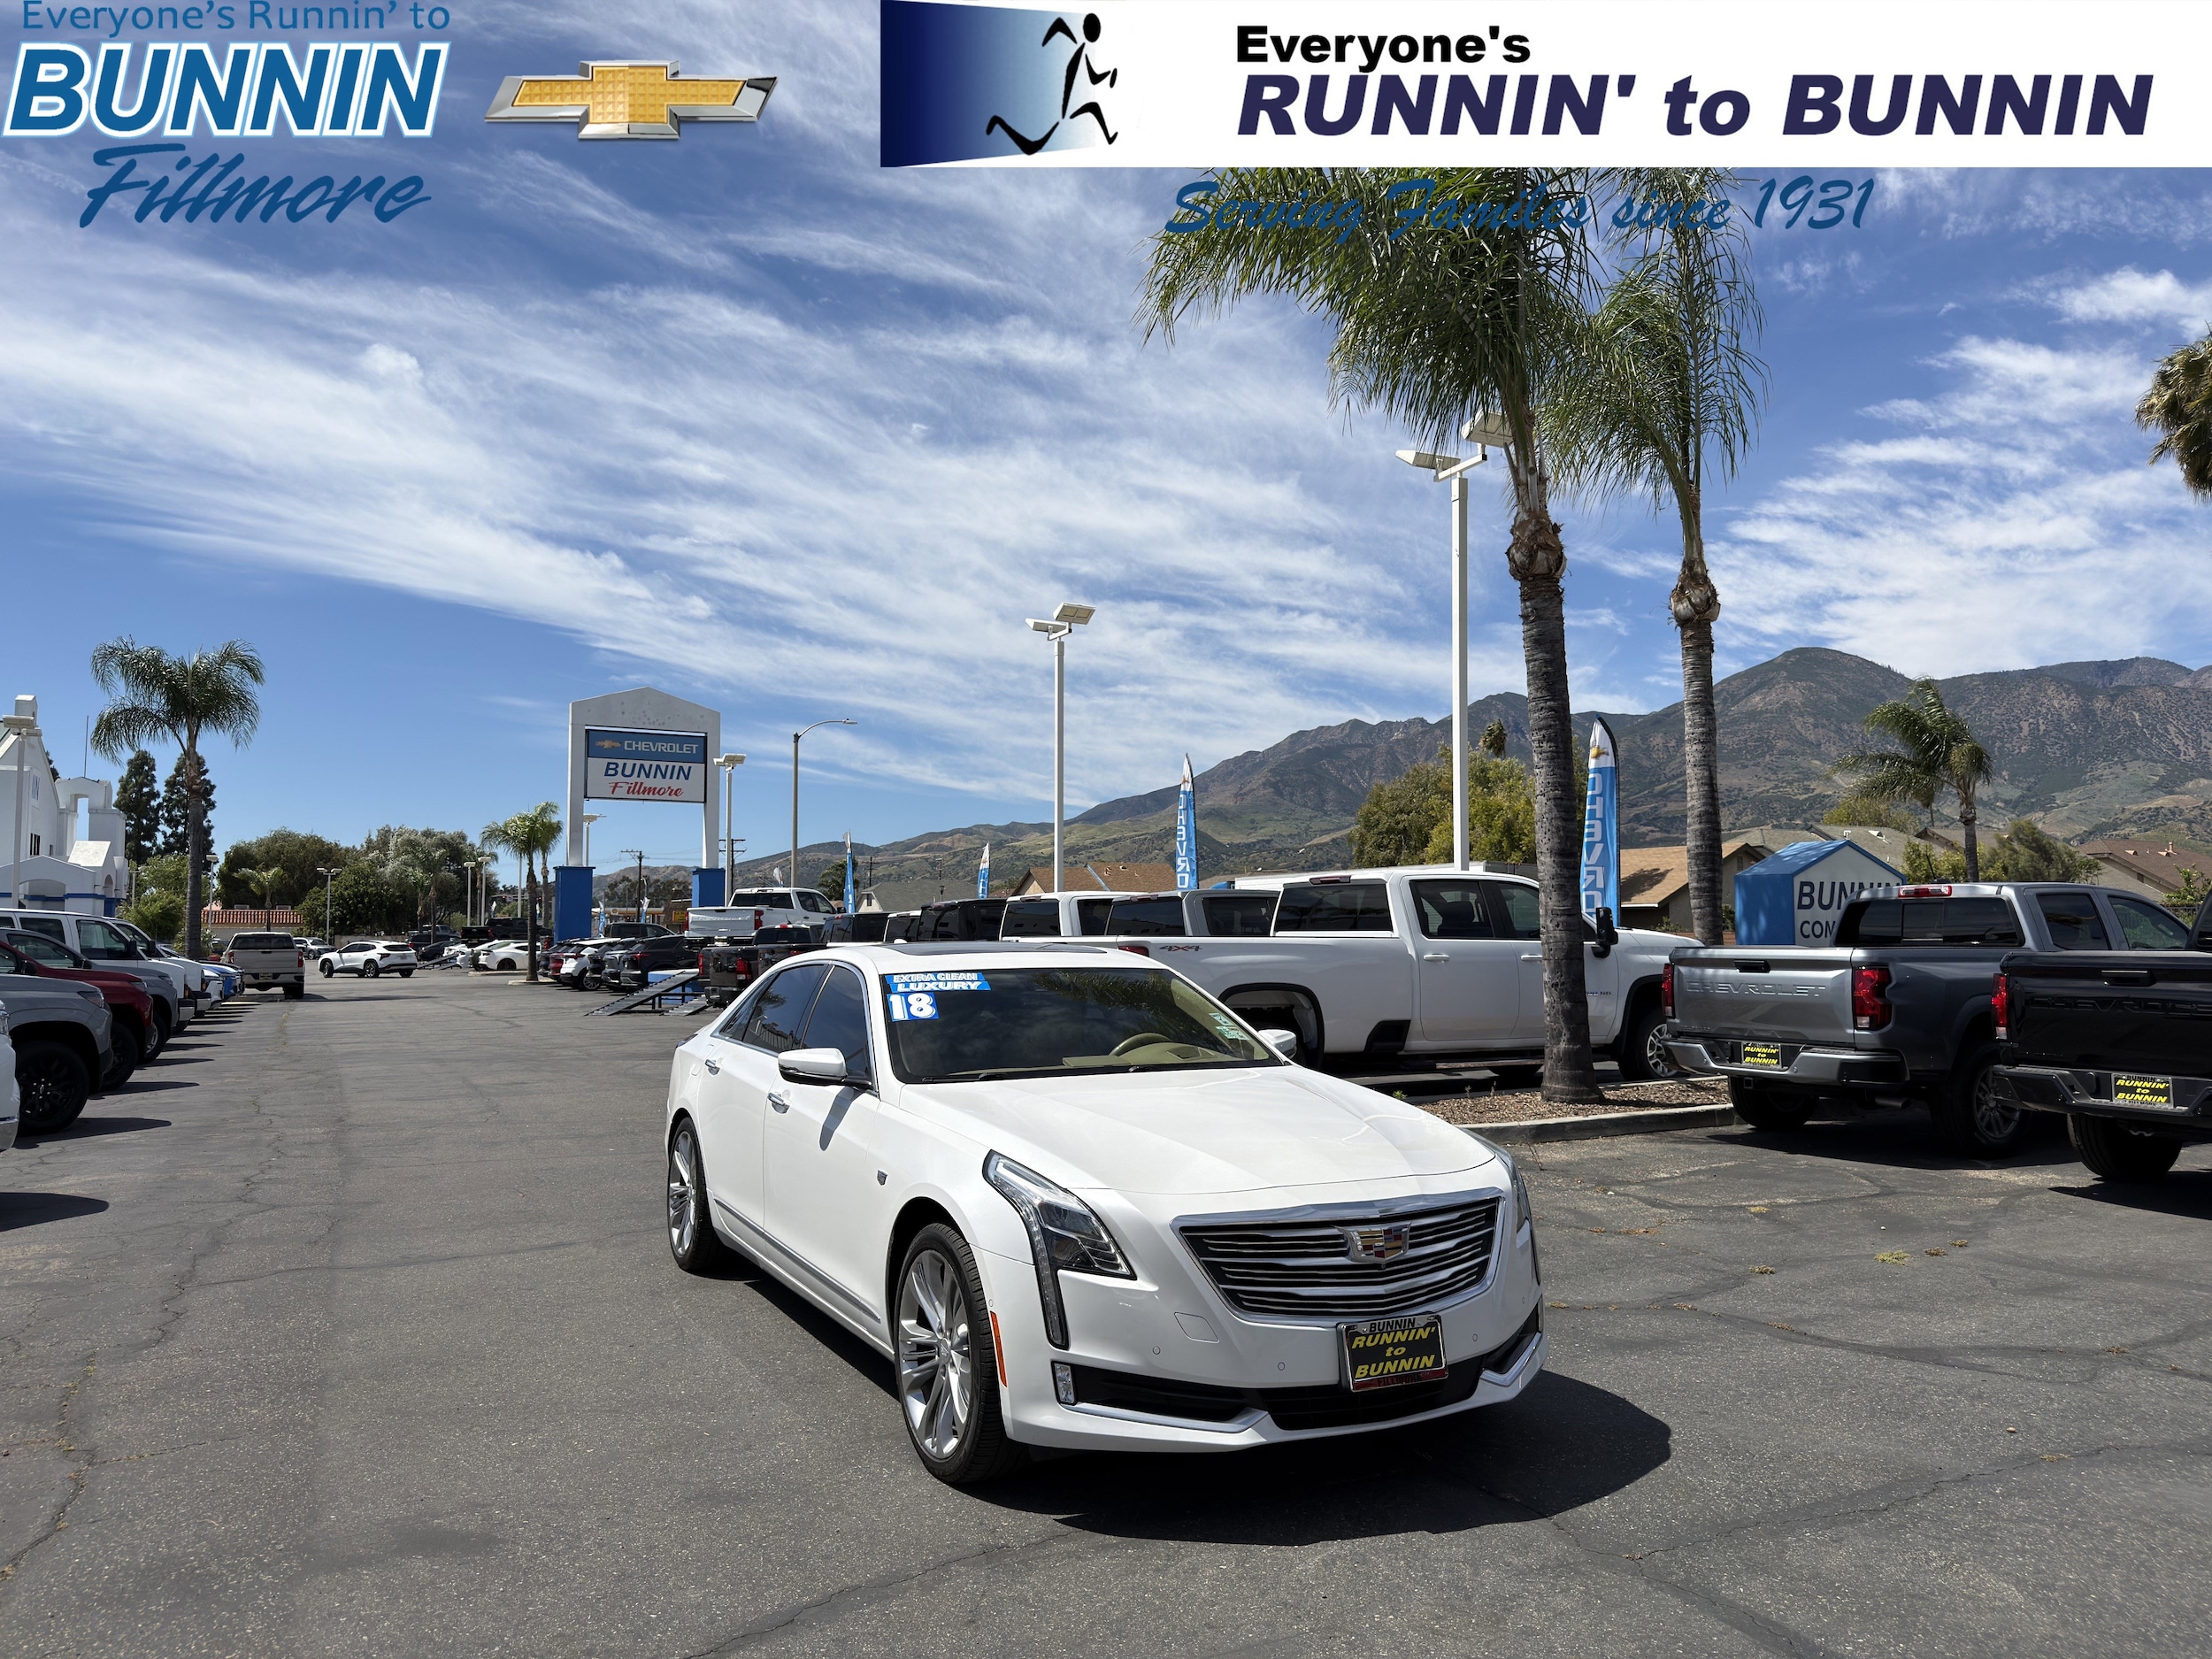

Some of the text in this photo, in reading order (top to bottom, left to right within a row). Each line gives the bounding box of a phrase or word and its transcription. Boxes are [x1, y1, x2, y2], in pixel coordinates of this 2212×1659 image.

[624, 740, 698, 754] CHEVROLET
[603, 762, 692, 780] BUNNIN
[609, 781, 684, 797] Fillmore
[1797, 881, 1901, 910] BUN
[893, 972, 979, 983] EXTRA CLEAN
[897, 980, 983, 992] LUXURY
[1686, 981, 1825, 997] CHEVROLET
[889, 992, 936, 1021] 18
[2116, 1079, 2170, 1089] RUNNIN'
[2116, 1092, 2168, 1102] BUNNIN
[1369, 1317, 1416, 1333] BUNNIN
[1352, 1326, 1435, 1349] RUNNIN'
[1385, 1346, 1407, 1357] to
[1355, 1354, 1435, 1379] BUNNIN
